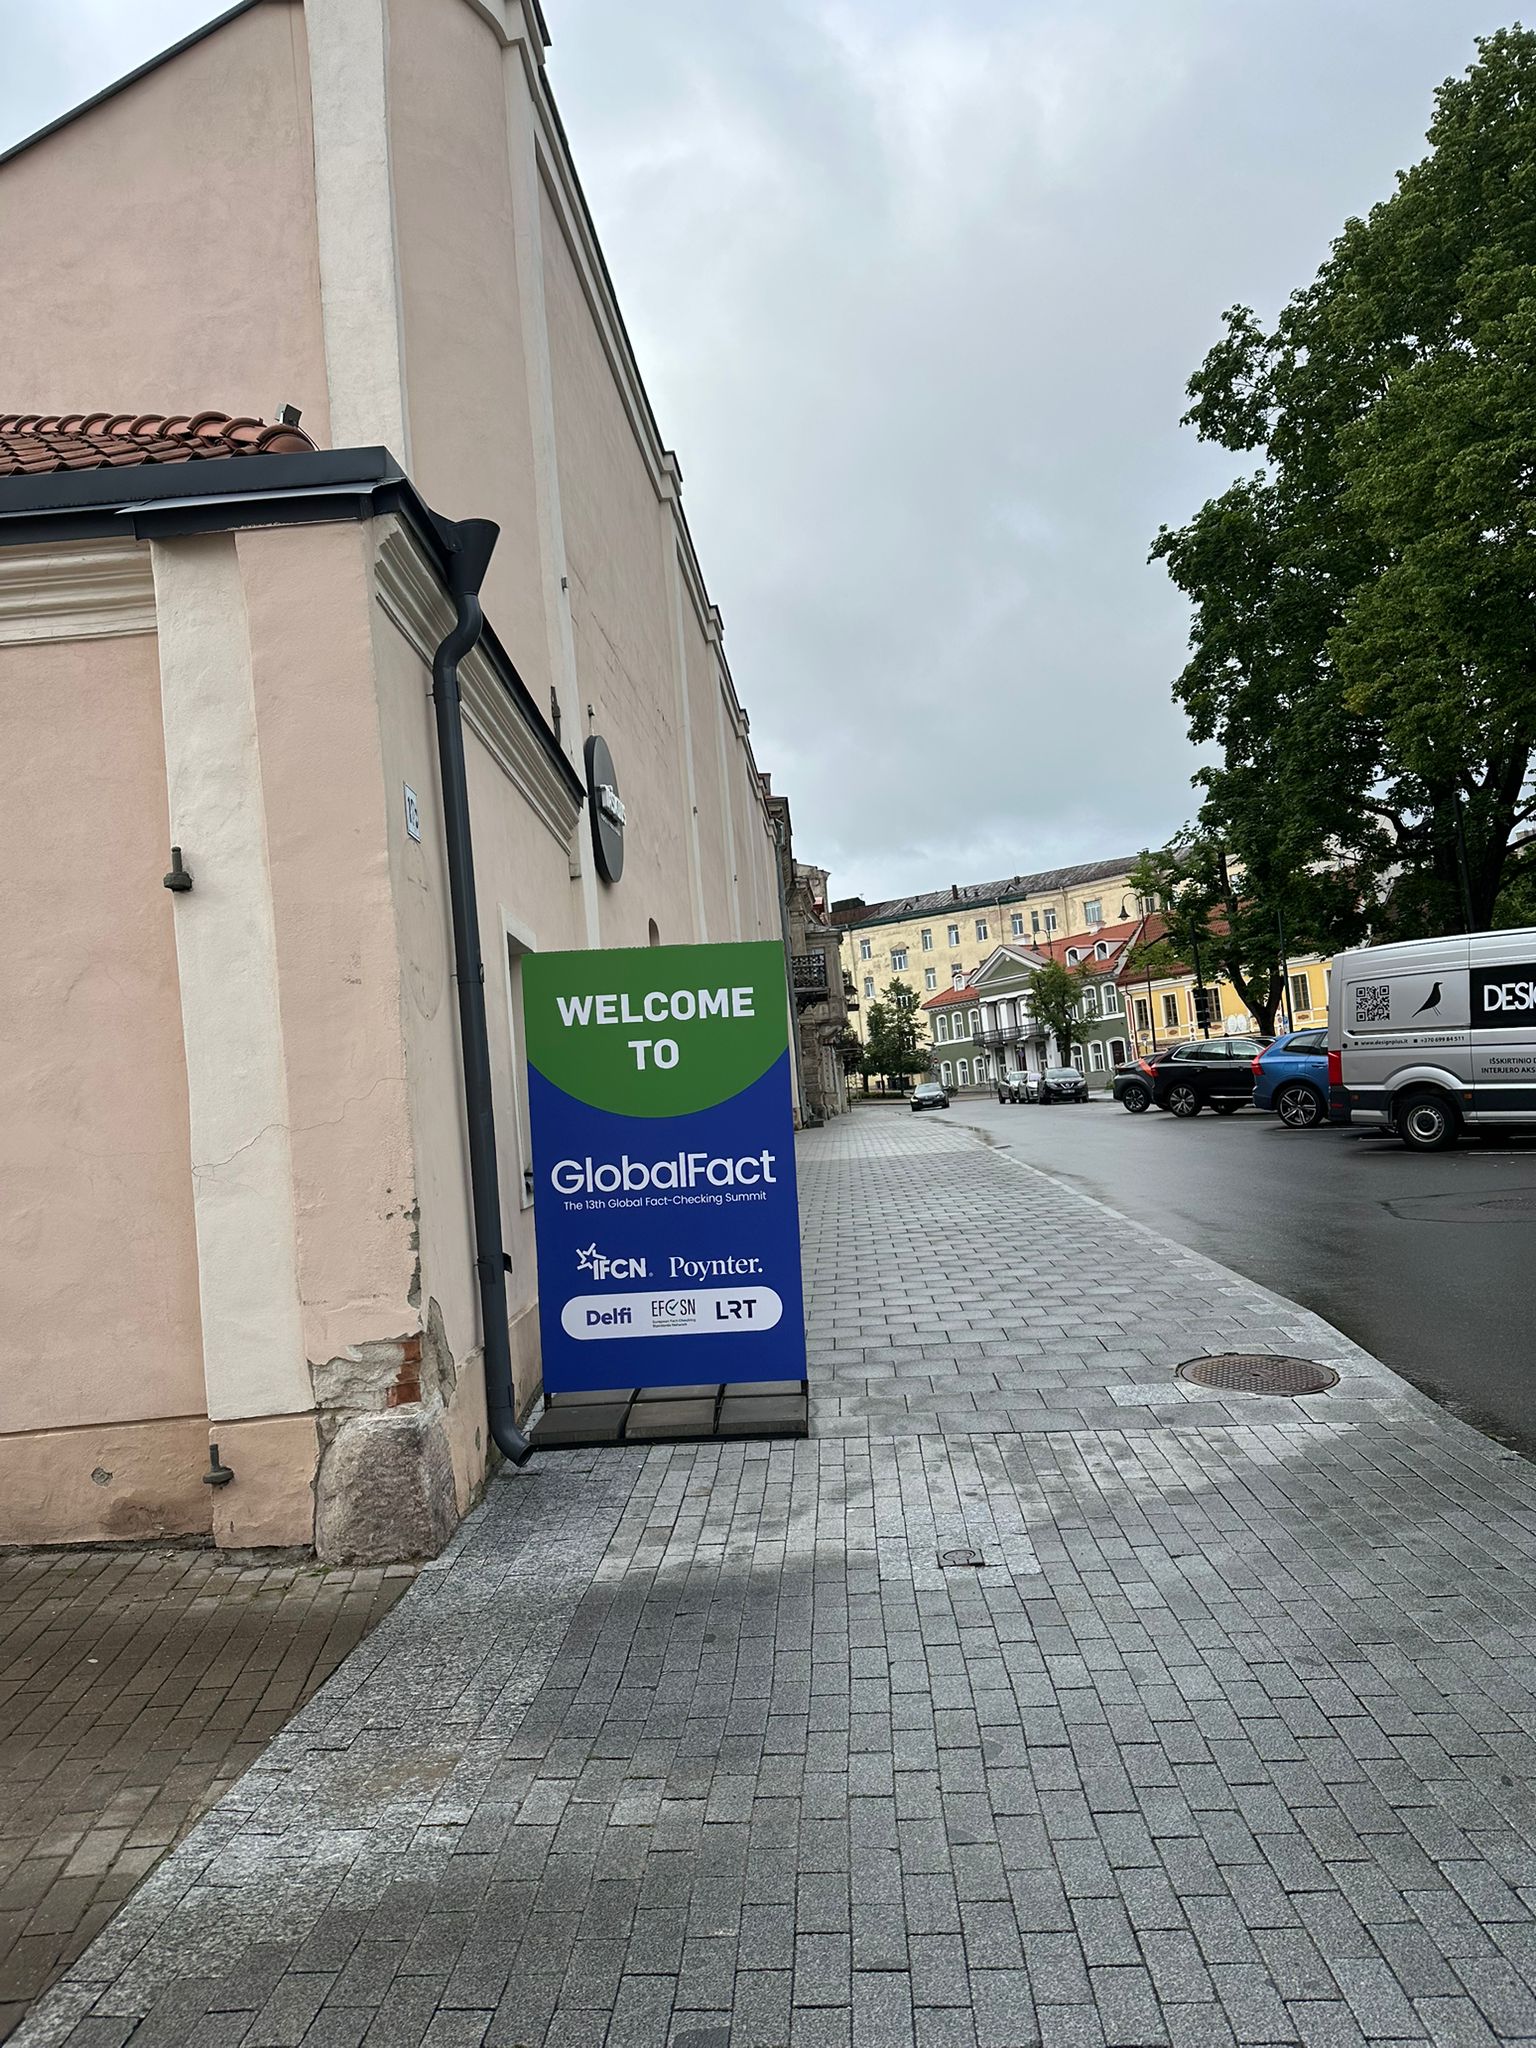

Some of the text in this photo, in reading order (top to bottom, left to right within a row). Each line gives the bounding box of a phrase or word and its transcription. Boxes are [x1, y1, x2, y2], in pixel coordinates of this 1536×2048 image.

[556, 986, 755, 1027] WELCOME
[628, 1038, 680, 1071] TO
[1489, 1057, 1532, 1065] IŠSKIRTINIO
[1481, 1066, 1520, 1074] INTERJERO
[550, 1149, 777, 1195] GlobalFact
[564, 1190, 767, 1211] The 13th Global Fact-Checking Summit
[668, 1255, 763, 1282] Poynter.
[586, 1307, 632, 1326] Delfi
[651, 1298, 697, 1317] EFCSN
[715, 1299, 758, 1321] LRT
